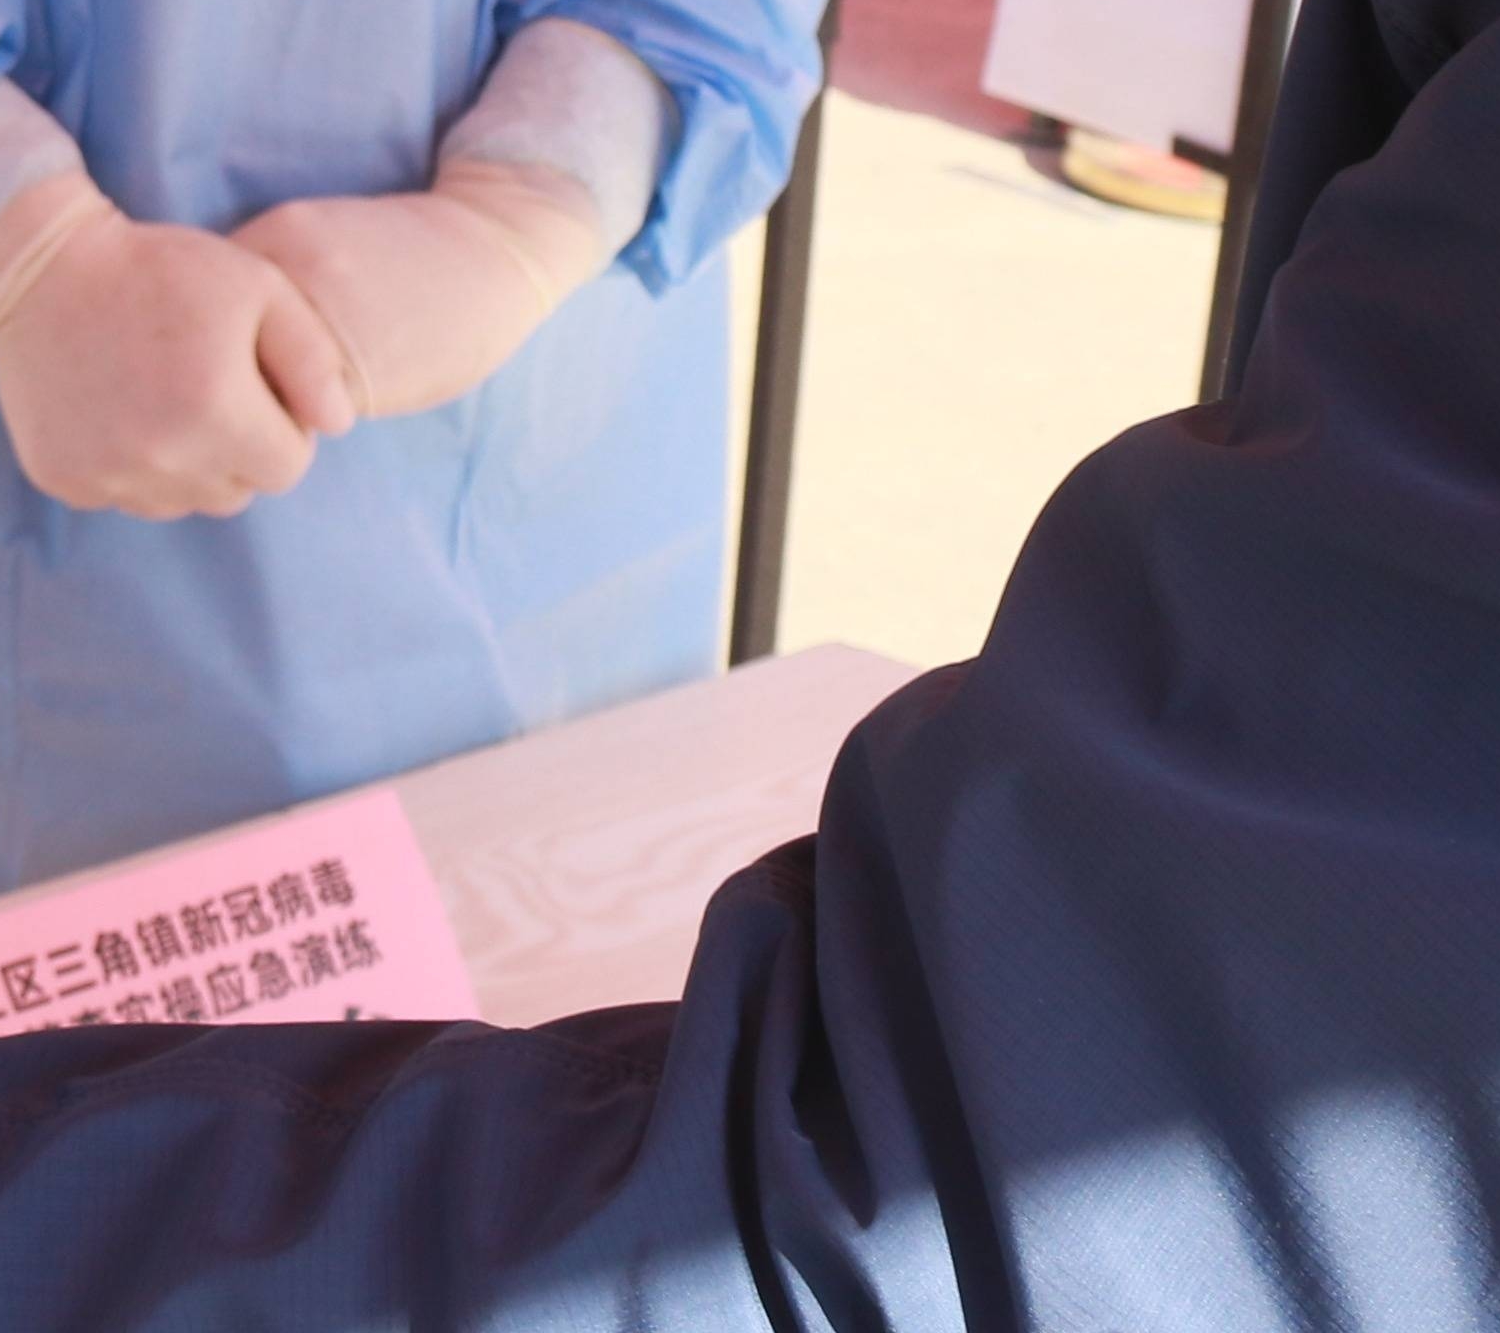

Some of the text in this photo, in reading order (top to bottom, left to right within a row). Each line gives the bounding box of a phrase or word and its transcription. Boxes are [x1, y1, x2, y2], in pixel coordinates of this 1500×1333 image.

[26, 919, 384, 1025] 实操应急演练
